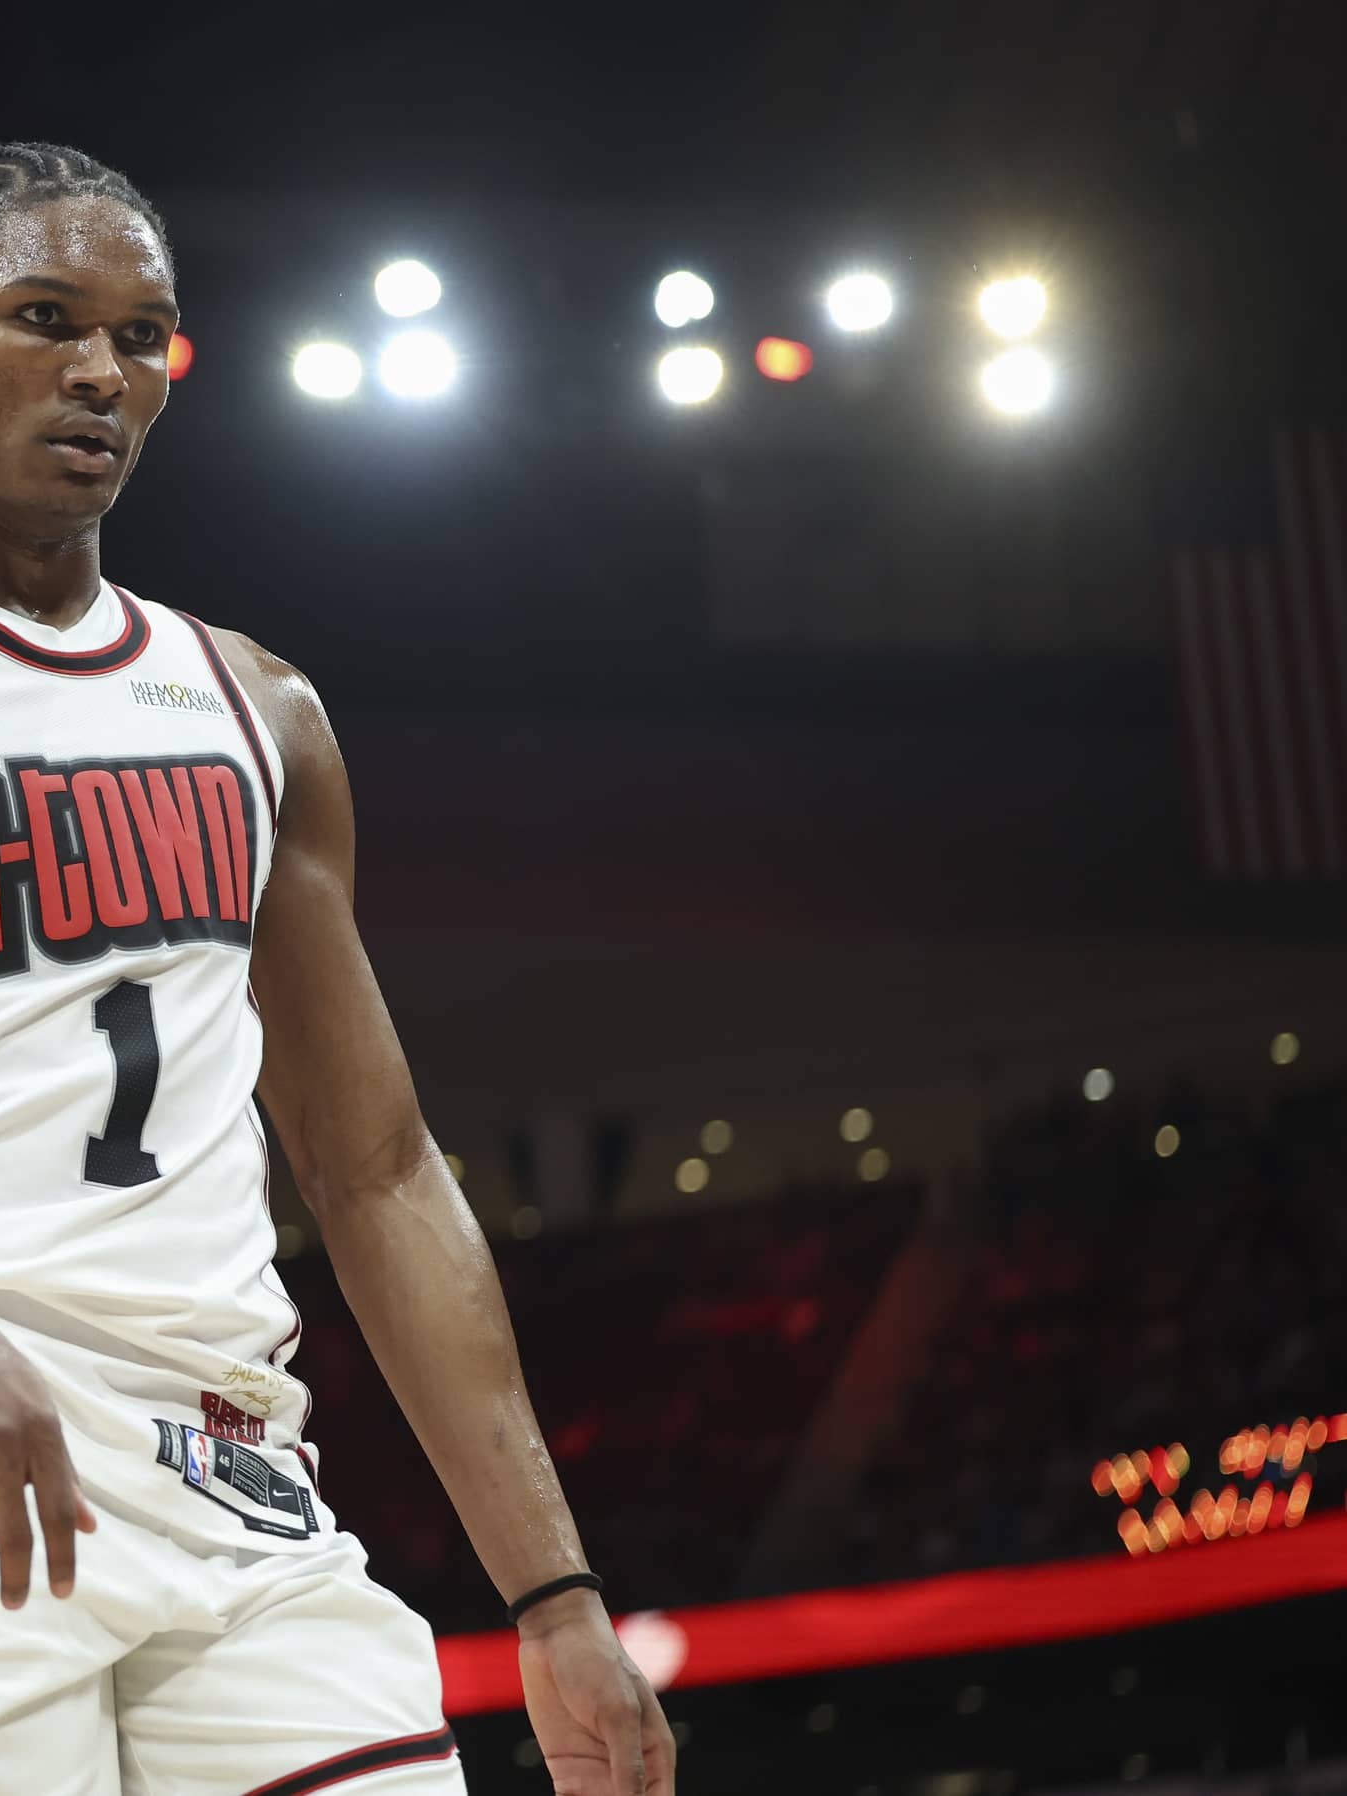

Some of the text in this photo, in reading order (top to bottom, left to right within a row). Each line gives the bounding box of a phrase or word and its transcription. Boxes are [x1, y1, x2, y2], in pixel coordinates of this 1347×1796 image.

[130, 679, 221, 707] MEMORIAL
[133, 690, 225, 715] HERMANN
[82, 979, 161, 1187] 1
